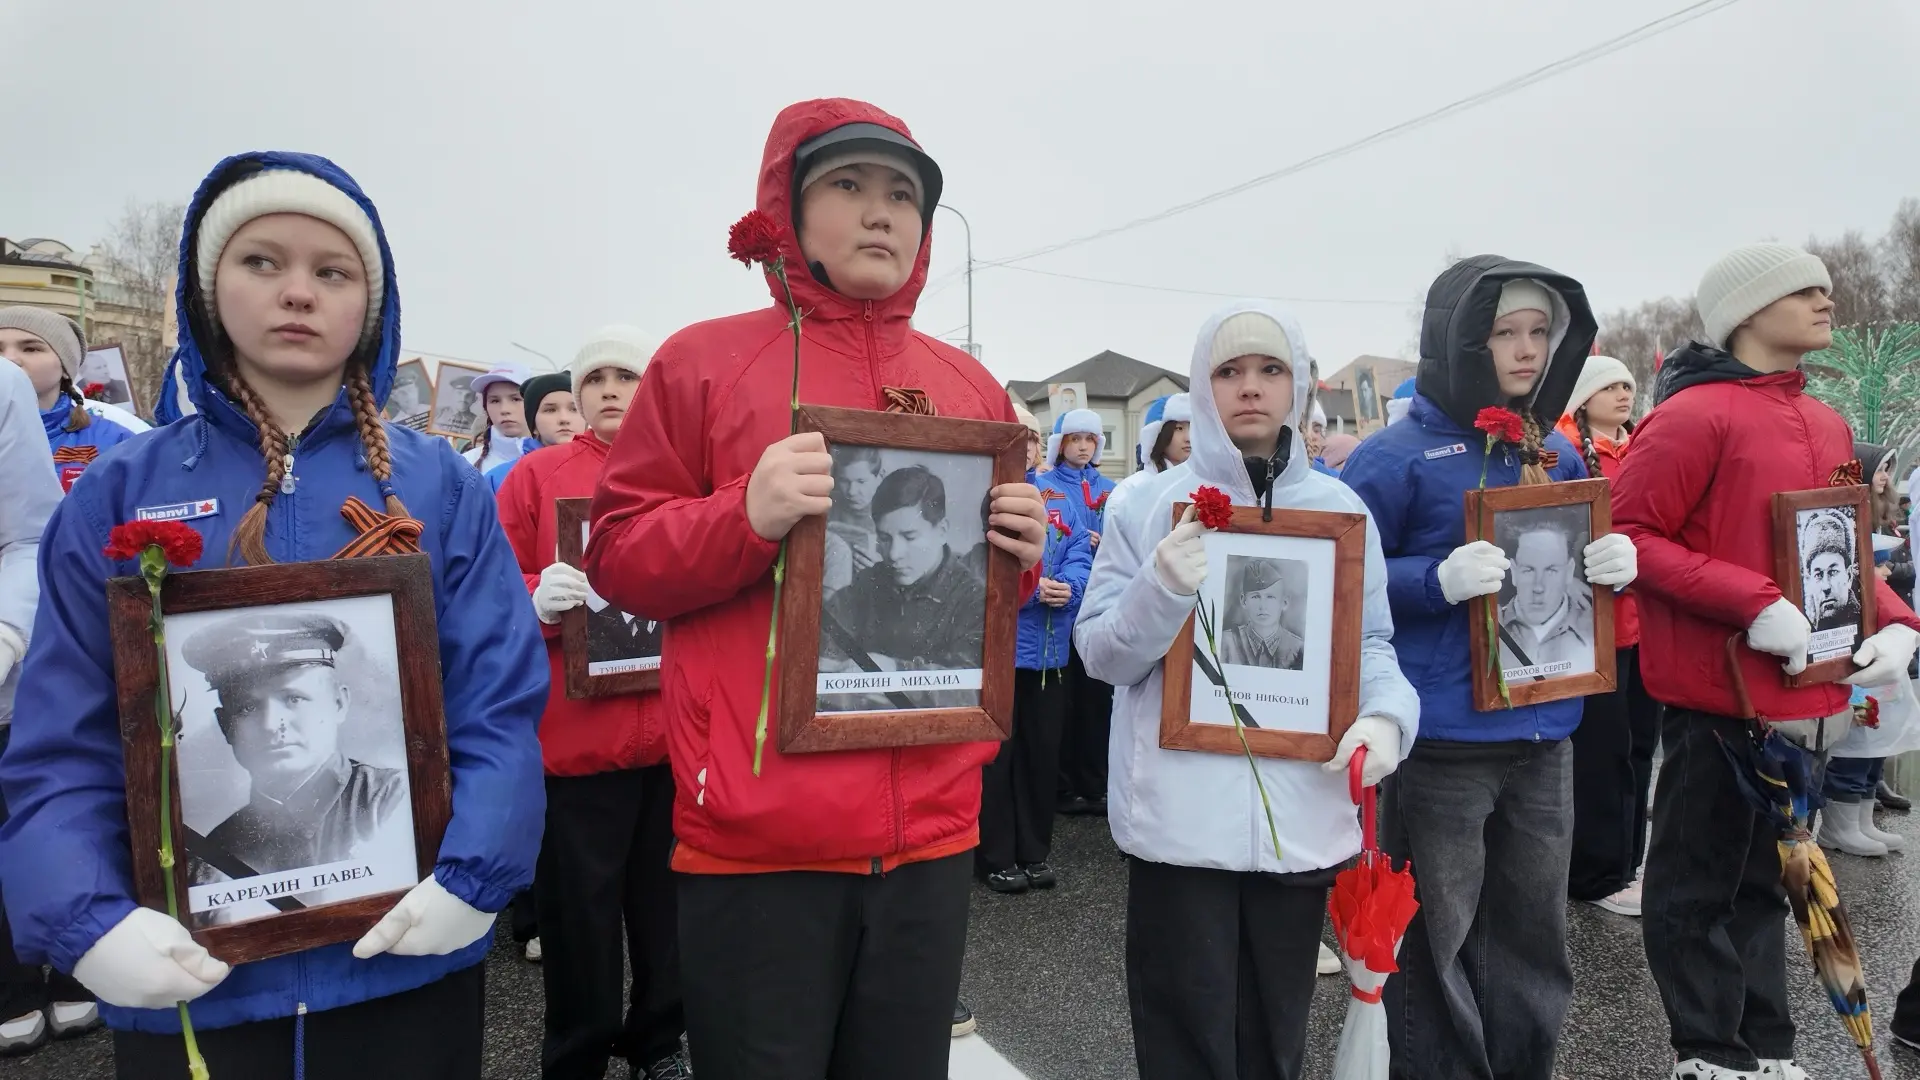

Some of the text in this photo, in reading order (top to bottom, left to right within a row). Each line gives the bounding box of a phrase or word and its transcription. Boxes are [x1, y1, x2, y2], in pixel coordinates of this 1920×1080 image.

[640, 661, 661, 669] БОРИ
[1503, 661, 1572, 678] ГОРОХОВ СЕРГЕЙ
[825, 674, 960, 690] КОРЯКИН МИХАИЛ
[1256, 693, 1309, 706] НИКОЛАЙ
[207, 865, 374, 907] КАРЕЛИН ПАВЕЛ
